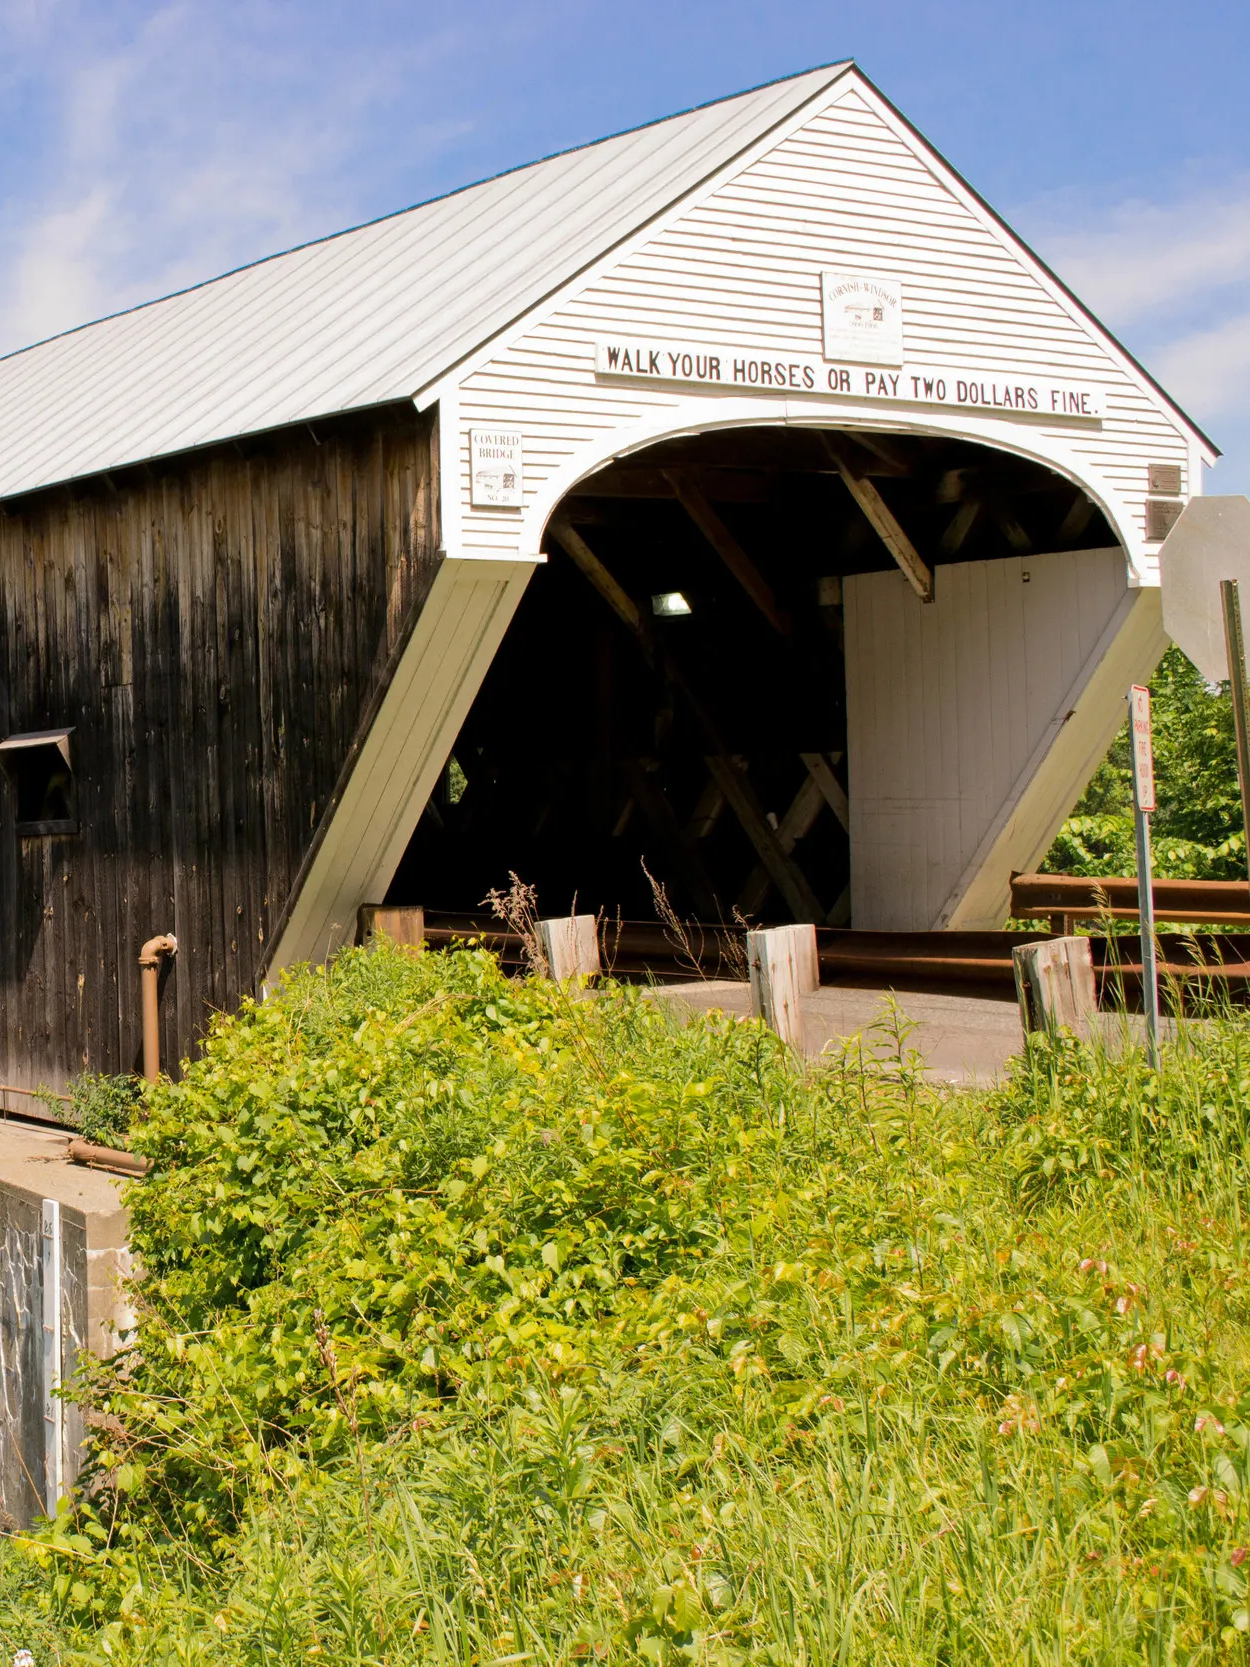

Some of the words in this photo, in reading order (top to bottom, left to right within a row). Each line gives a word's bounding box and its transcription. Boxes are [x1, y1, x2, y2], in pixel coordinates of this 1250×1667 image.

[828, 281, 897, 308] CORNISH-WINDSOR
[607, 346, 661, 375] WALK
[667, 351, 721, 381] YOUR
[733, 358, 815, 389] HORSES
[828, 368, 851, 392] OR
[865, 371, 900, 396] PAY
[910, 376, 946, 400] TWO
[956, 380, 1039, 409] DOLLARS
[1051, 390, 1099, 415] FINE.
[474, 434, 519, 446] COVERED
[479, 447, 515, 459] BRIDGE
